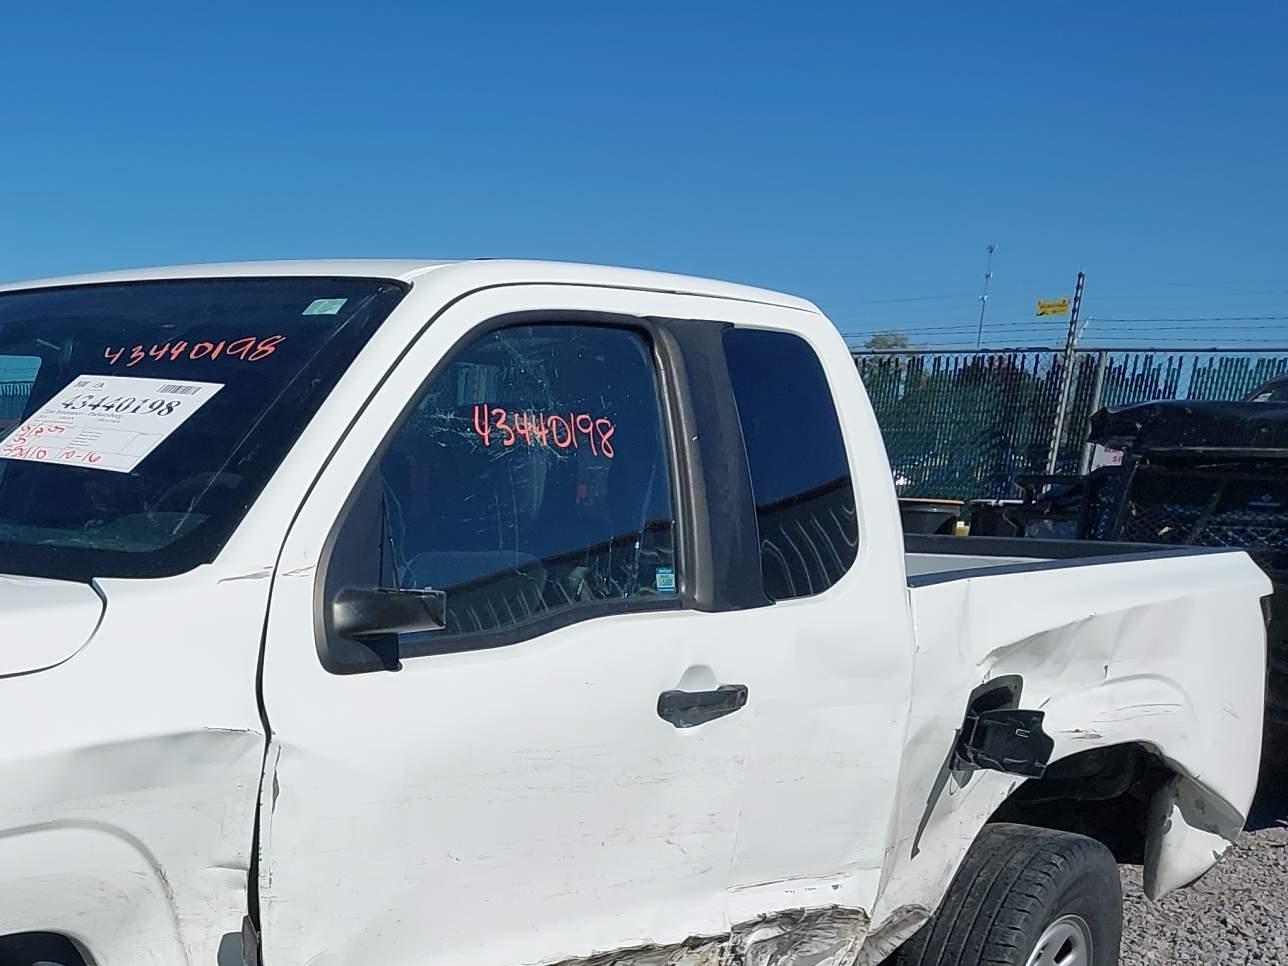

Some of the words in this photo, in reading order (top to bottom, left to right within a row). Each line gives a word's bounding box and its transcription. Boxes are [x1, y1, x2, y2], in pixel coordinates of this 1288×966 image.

[104, 333, 286, 368] 43440198
[61, 393, 182, 417] 43440198
[474, 403, 615, 458] 43440198
